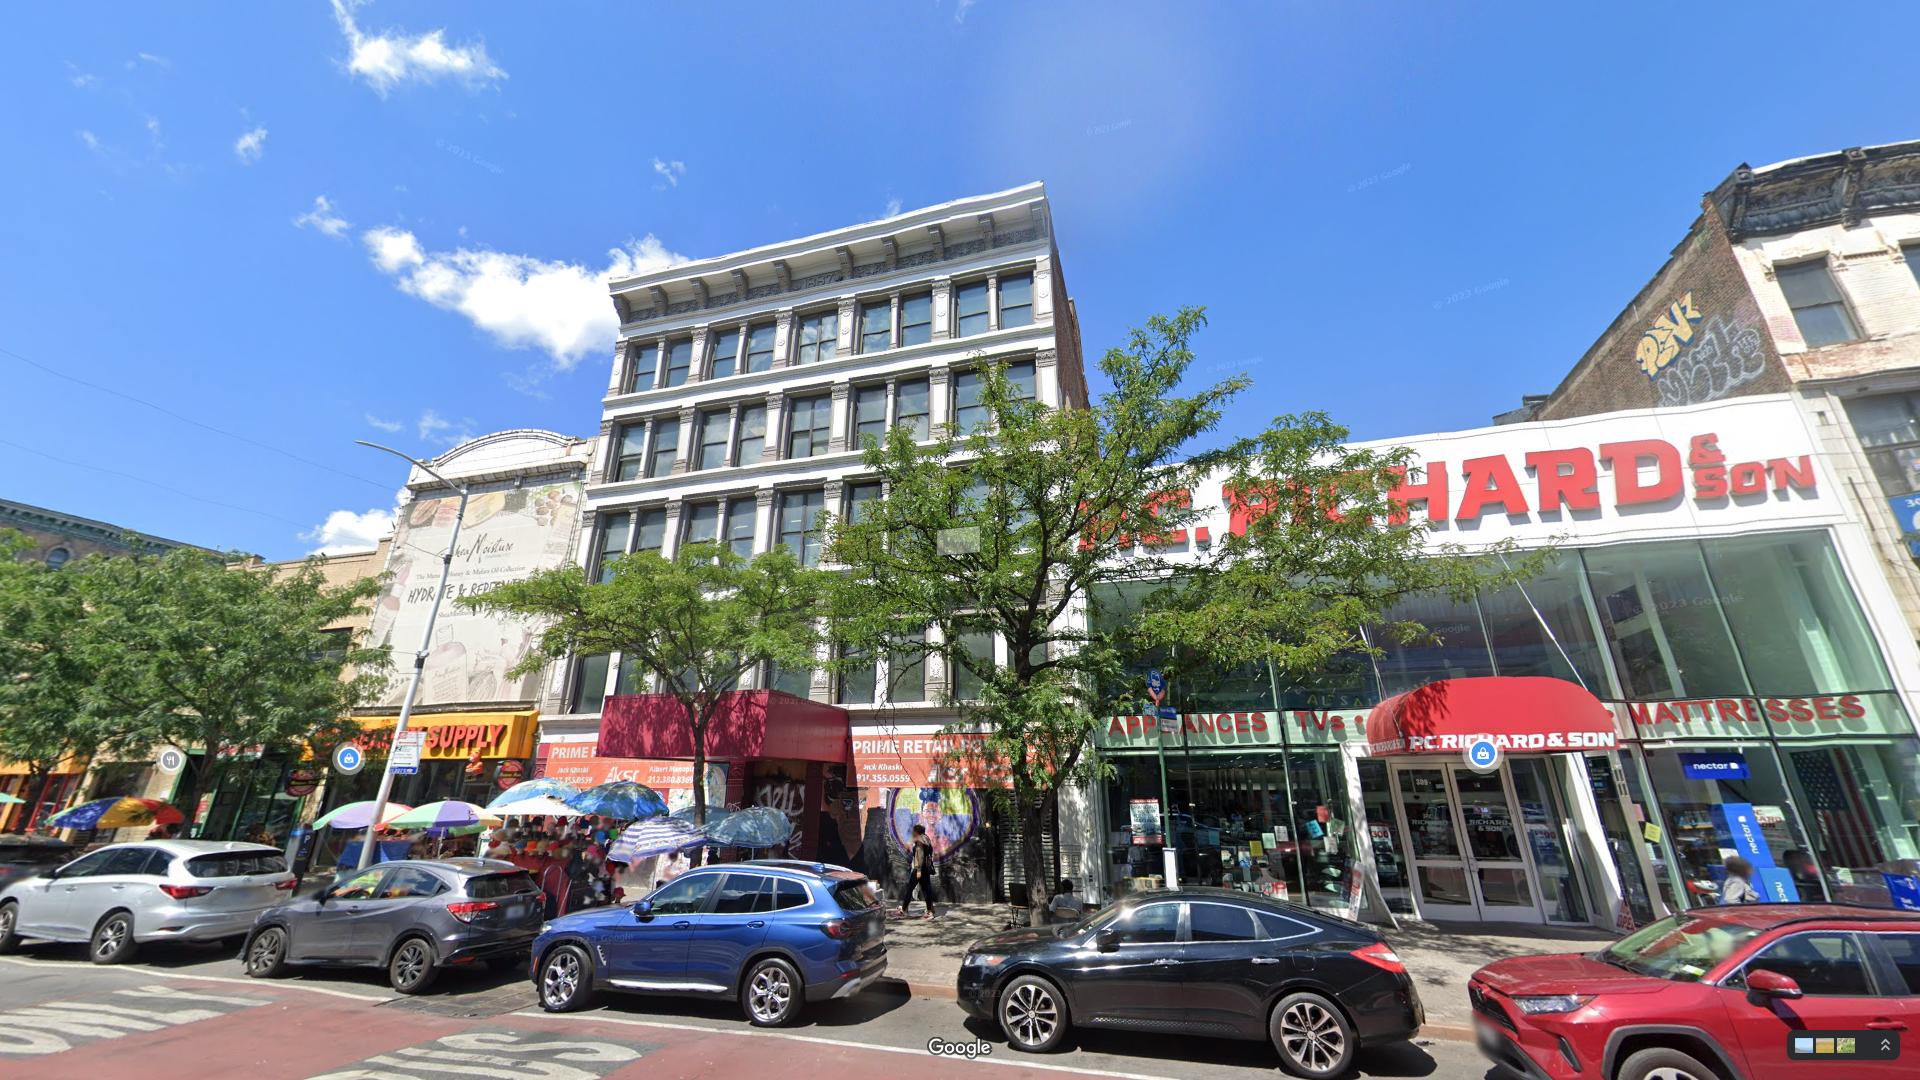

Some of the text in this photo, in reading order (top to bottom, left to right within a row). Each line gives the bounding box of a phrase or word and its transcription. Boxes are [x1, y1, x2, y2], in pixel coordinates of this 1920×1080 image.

[1690, 432, 1726, 467] &
[1693, 455, 1817, 500] SON
[407, 583, 456, 605] HYDRTE
[1629, 694, 1866, 725] MATTRESSES
[1107, 711, 1268, 736] APPANCES
[1294, 710, 1345, 731] TVs
[426, 724, 505, 749] SUPPLY
[853, 739, 900, 754] PRIME
[1547, 732, 1566, 748] &
[1567, 732, 1615, 748] SON
[552, 746, 591, 759] PRIME
[1693, 762, 1729, 770] nectar
